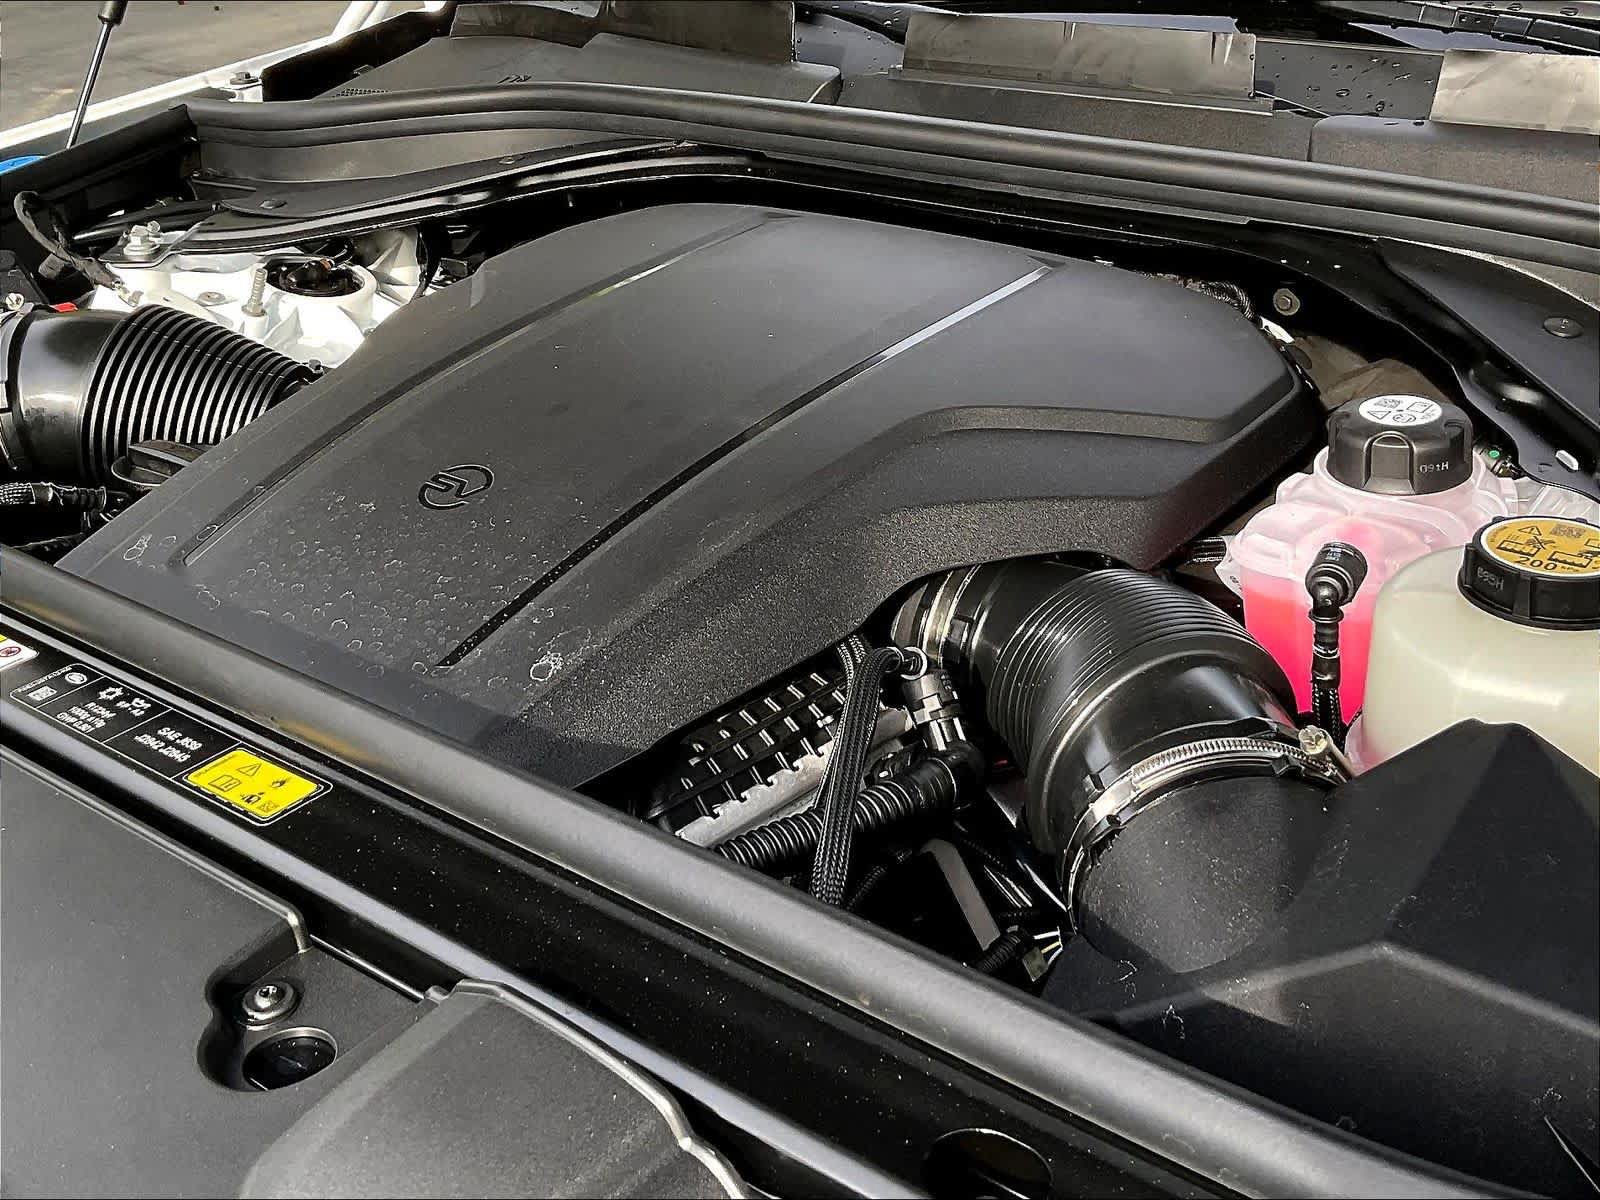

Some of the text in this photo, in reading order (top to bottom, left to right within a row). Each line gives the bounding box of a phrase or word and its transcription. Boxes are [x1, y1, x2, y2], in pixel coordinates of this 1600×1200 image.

[1514, 556, 1558, 571] 200
[134, 734, 191, 763] J2842 J2845
[158, 727, 203, 751] SAE J639
